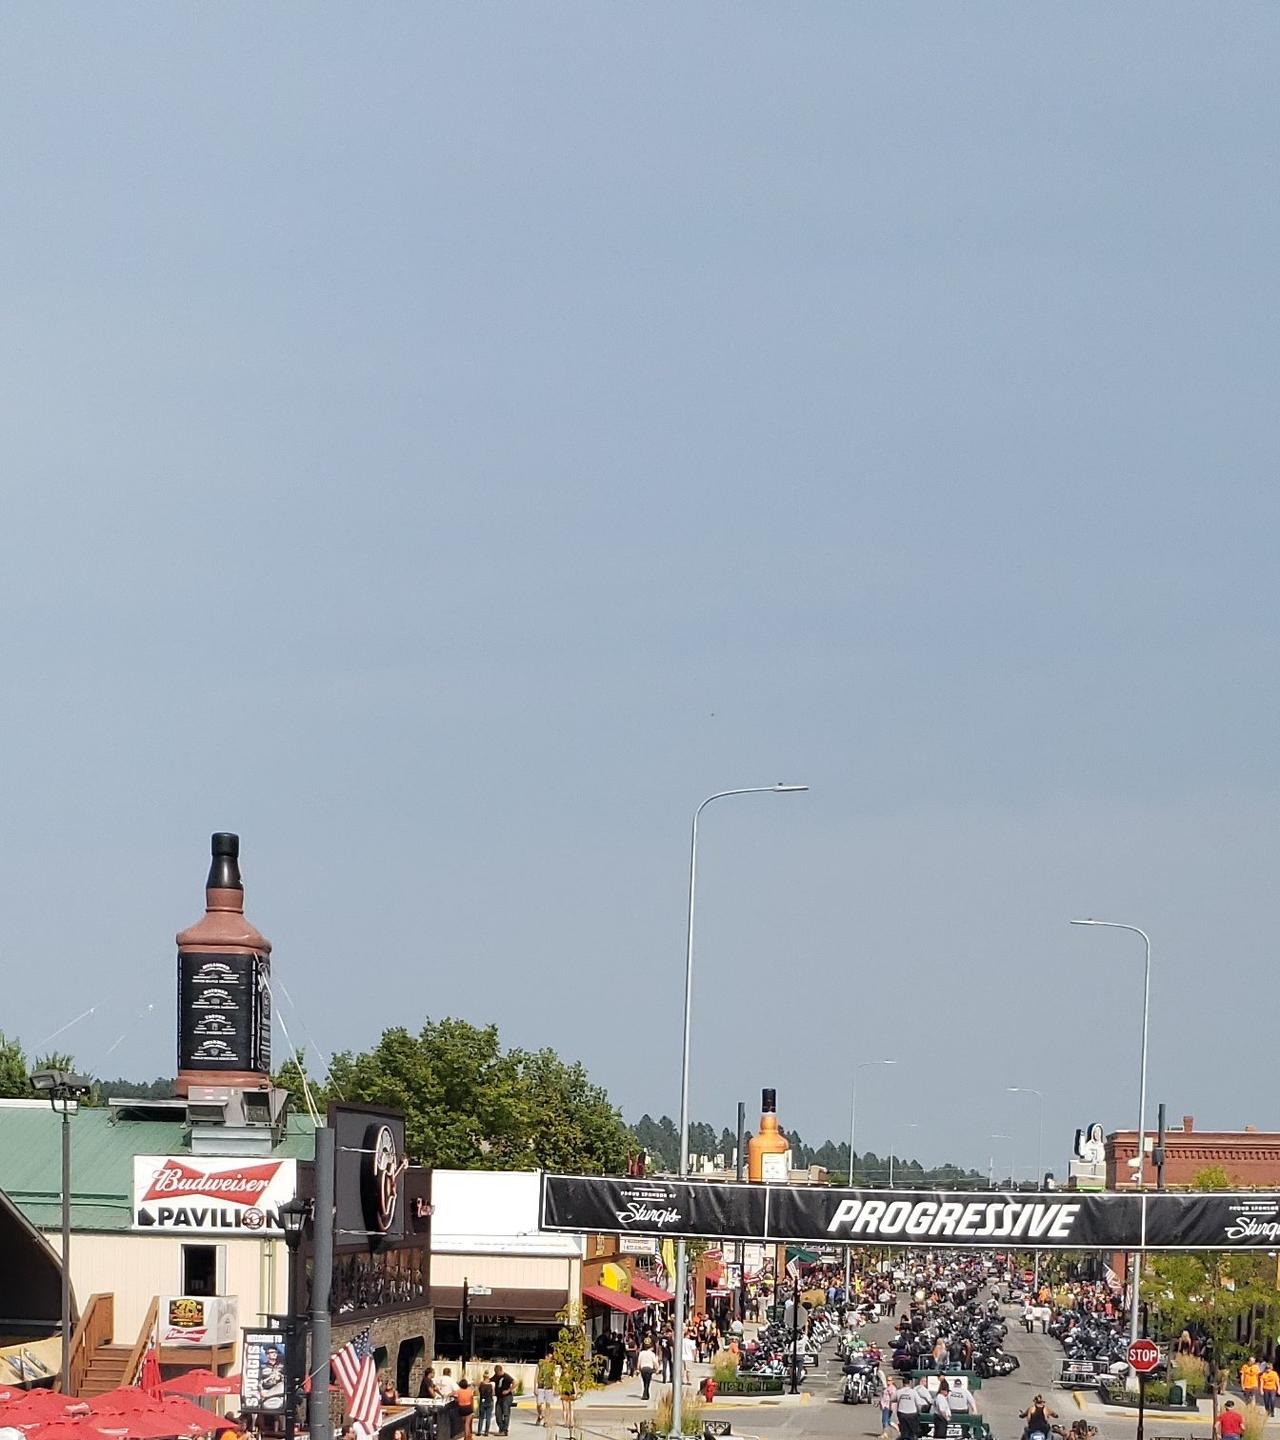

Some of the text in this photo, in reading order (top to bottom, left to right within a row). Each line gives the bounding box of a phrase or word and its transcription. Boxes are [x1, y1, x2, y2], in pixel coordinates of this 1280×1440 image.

[152, 1168, 270, 1192] Budweiser
[615, 1202, 681, 1227] Sturgis
[827, 1199, 1081, 1237] PROGRESSIVE
[1129, 1348, 1157, 1362] STOP
[244, 1345, 261, 1407] STURGIS
